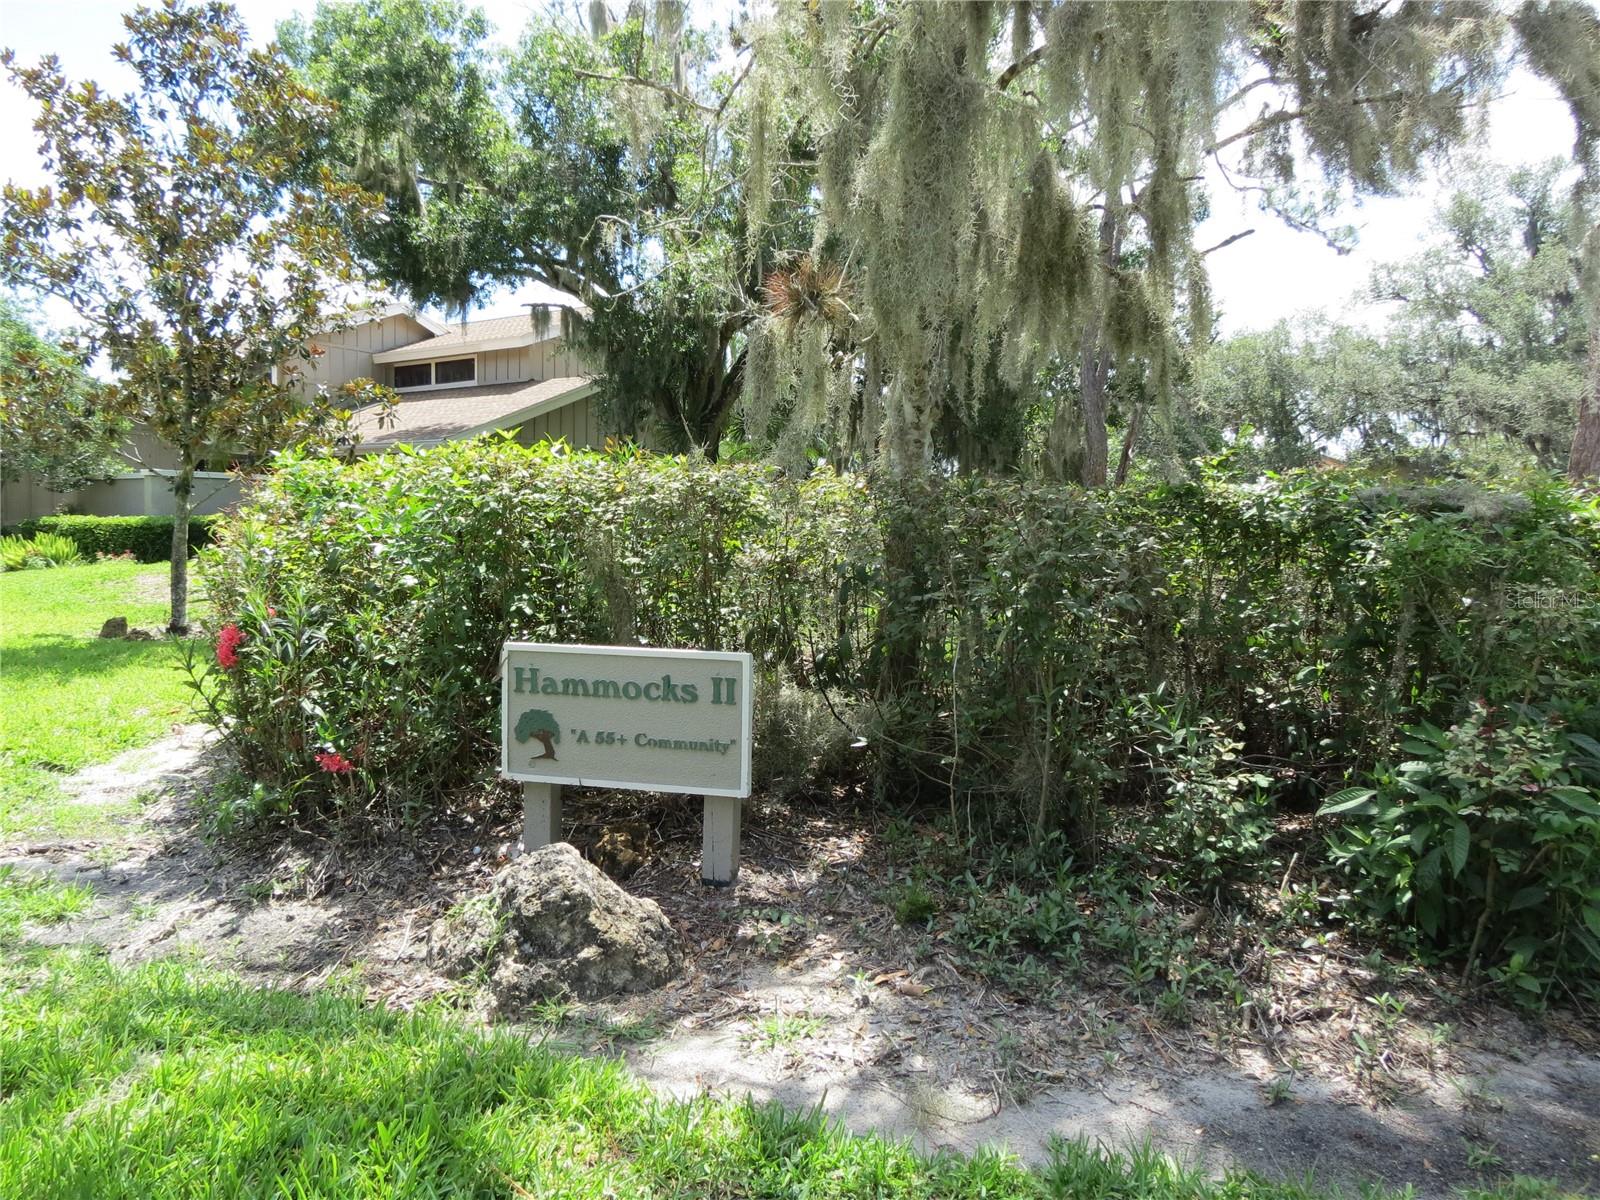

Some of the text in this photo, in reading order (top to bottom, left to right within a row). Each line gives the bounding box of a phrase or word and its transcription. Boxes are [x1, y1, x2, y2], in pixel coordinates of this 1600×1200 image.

[513, 666, 737, 705] Hammocks II
[634, 733, 737, 755] Community"
